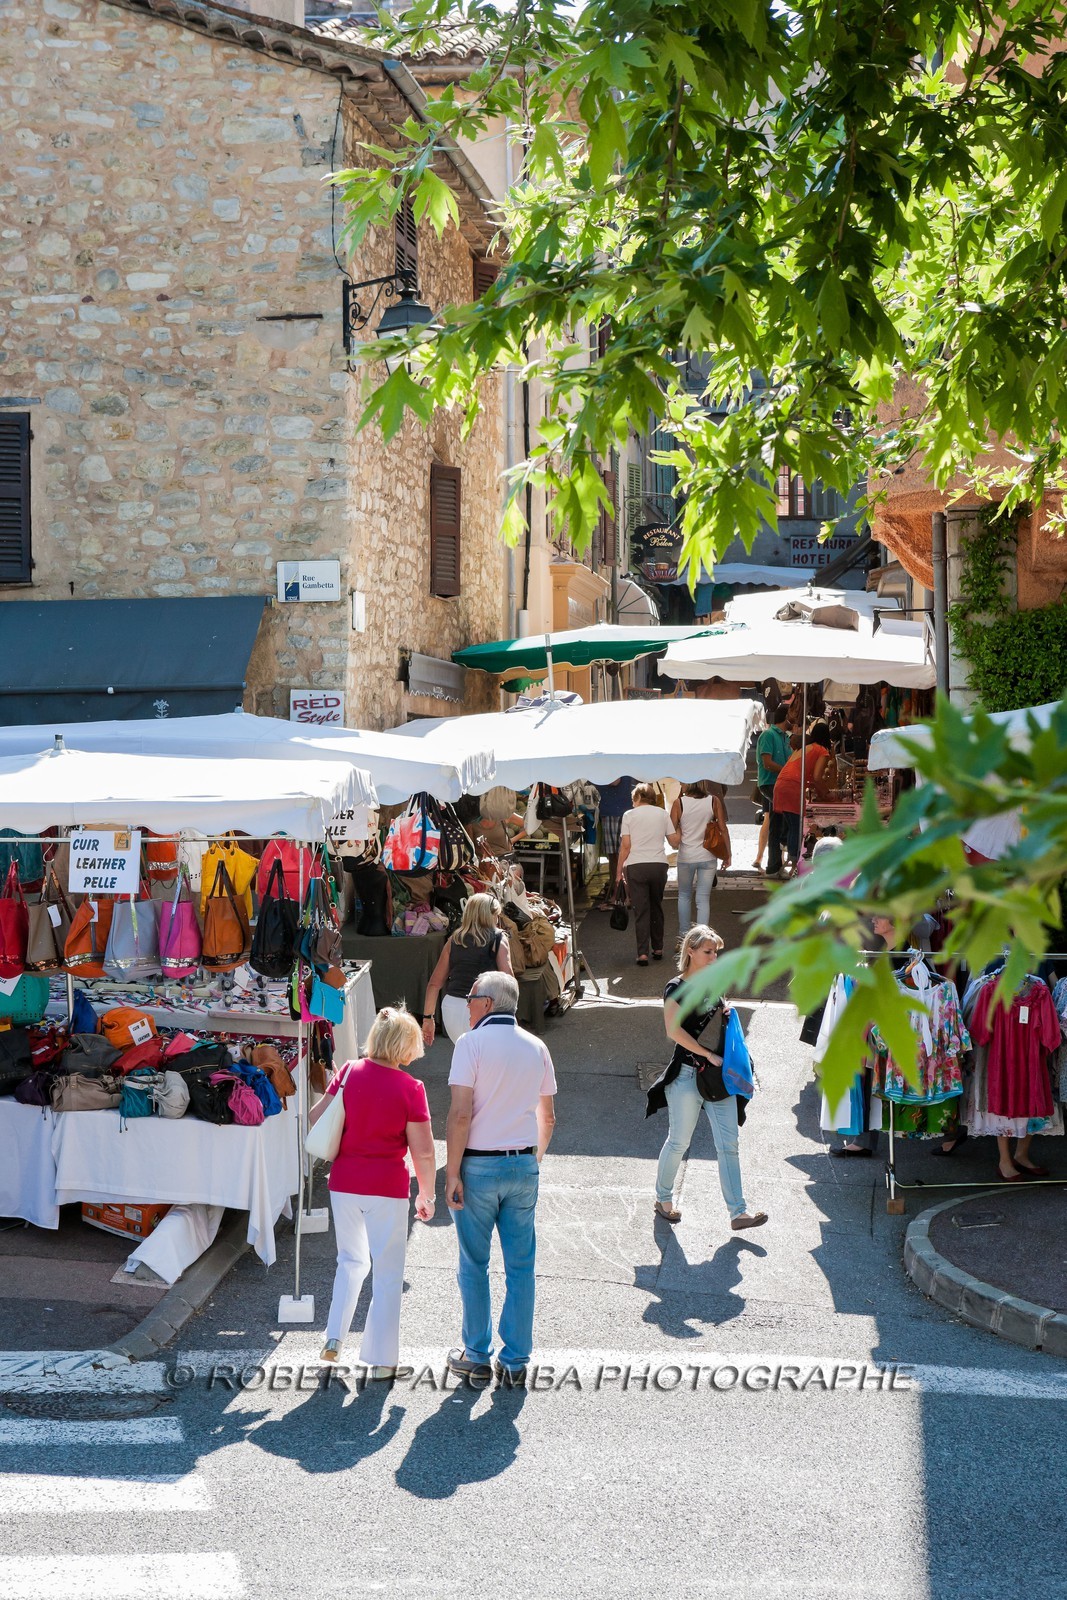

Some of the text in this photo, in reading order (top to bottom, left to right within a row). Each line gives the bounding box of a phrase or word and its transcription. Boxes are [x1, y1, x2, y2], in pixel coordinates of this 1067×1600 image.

[643, 528, 680, 540] RESTAURANT
[792, 538, 857, 550] RESTAURA
[293, 697, 341, 711] RED
[296, 710, 341, 725] Style
[72, 838, 100, 852] CUIR
[76, 857, 126, 871] LEATHER
[83, 876, 118, 889] PELLE
